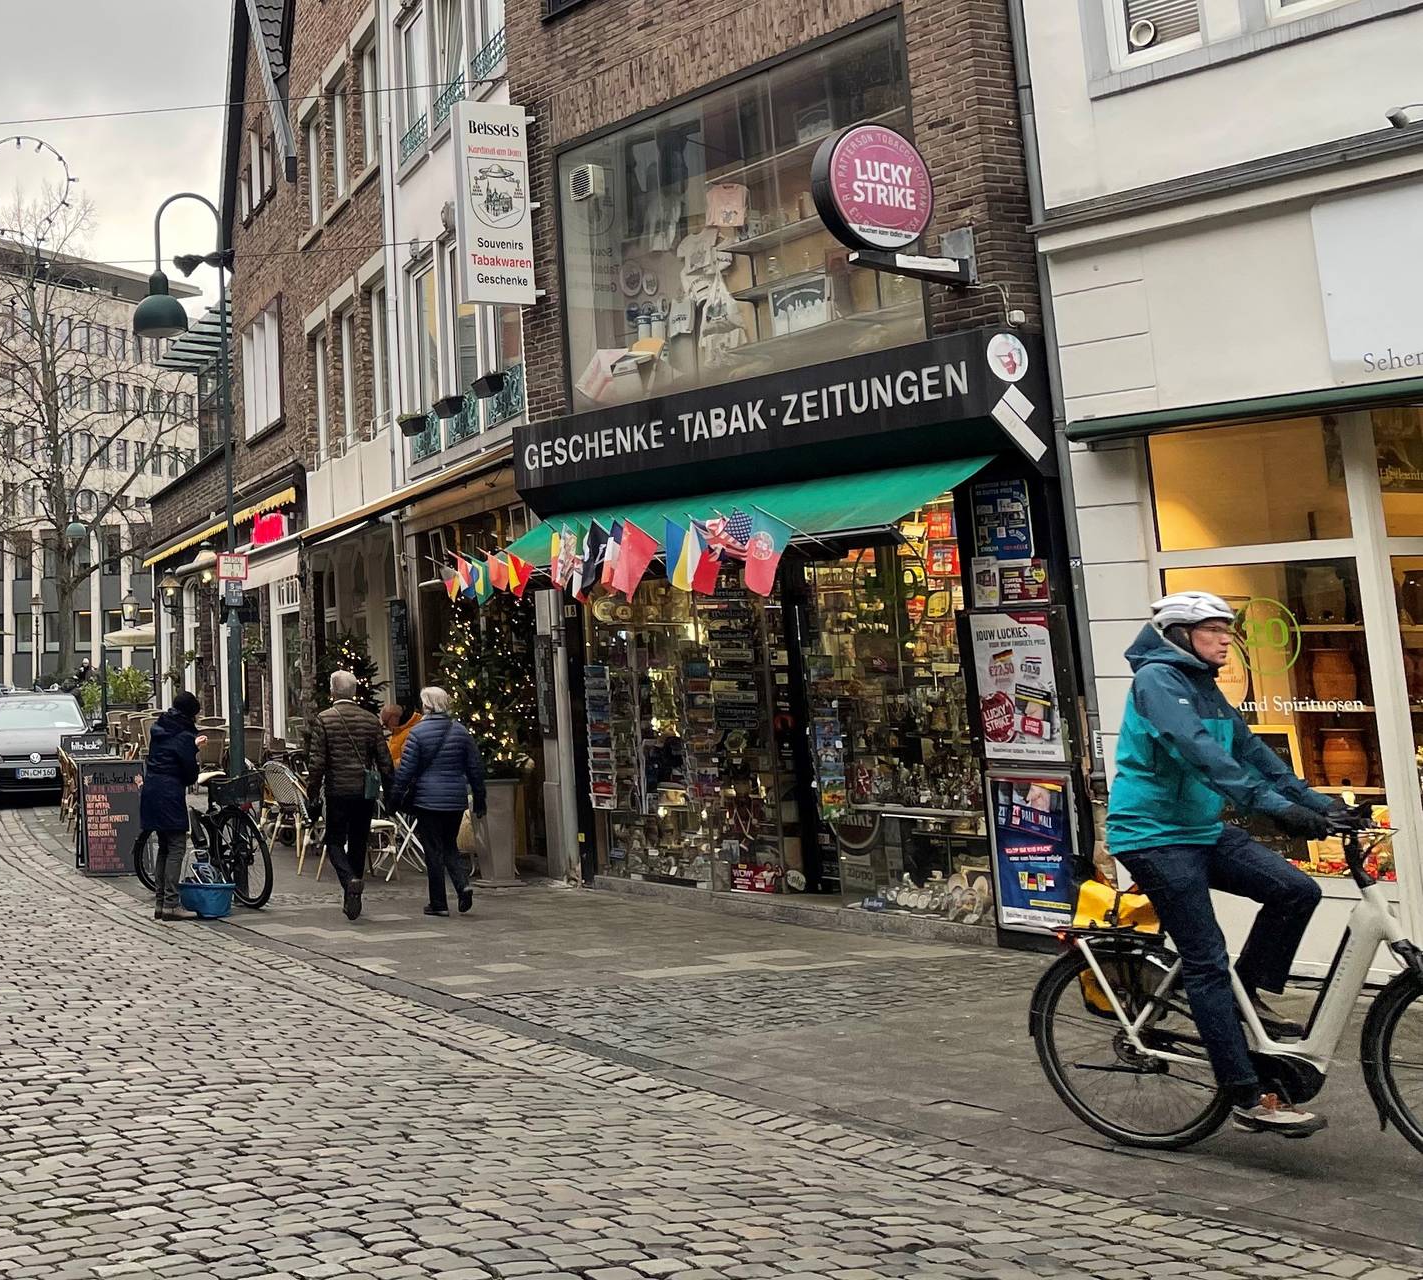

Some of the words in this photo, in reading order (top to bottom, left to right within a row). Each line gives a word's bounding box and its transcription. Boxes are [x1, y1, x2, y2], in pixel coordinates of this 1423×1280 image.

[468, 119, 520, 138] Beissel's
[853, 158, 913, 187] LUCKY
[852, 180, 917, 211] STRIKE
[477, 237, 524, 251] Souvenirs
[471, 253, 532, 269] Tabakwaren
[477, 273, 528, 287] Geschenke
[523, 418, 665, 472] GESCHENKE
[678, 398, 767, 444] TABAK
[780, 360, 970, 427] ZEITUNGEN
[565, 605, 576, 617] 18
[996, 626, 1031, 640] LUCKIES,
[1241, 618, 1289, 649] 20
[983, 703, 1007, 721] LUCKY
[1239, 696, 1268, 713] und
[1272, 695, 1365, 716] Spirituosen
[985, 714, 1012, 732] STRIKE
[20, 769, 29, 777] DN
[43, 768, 56, 776] 160
